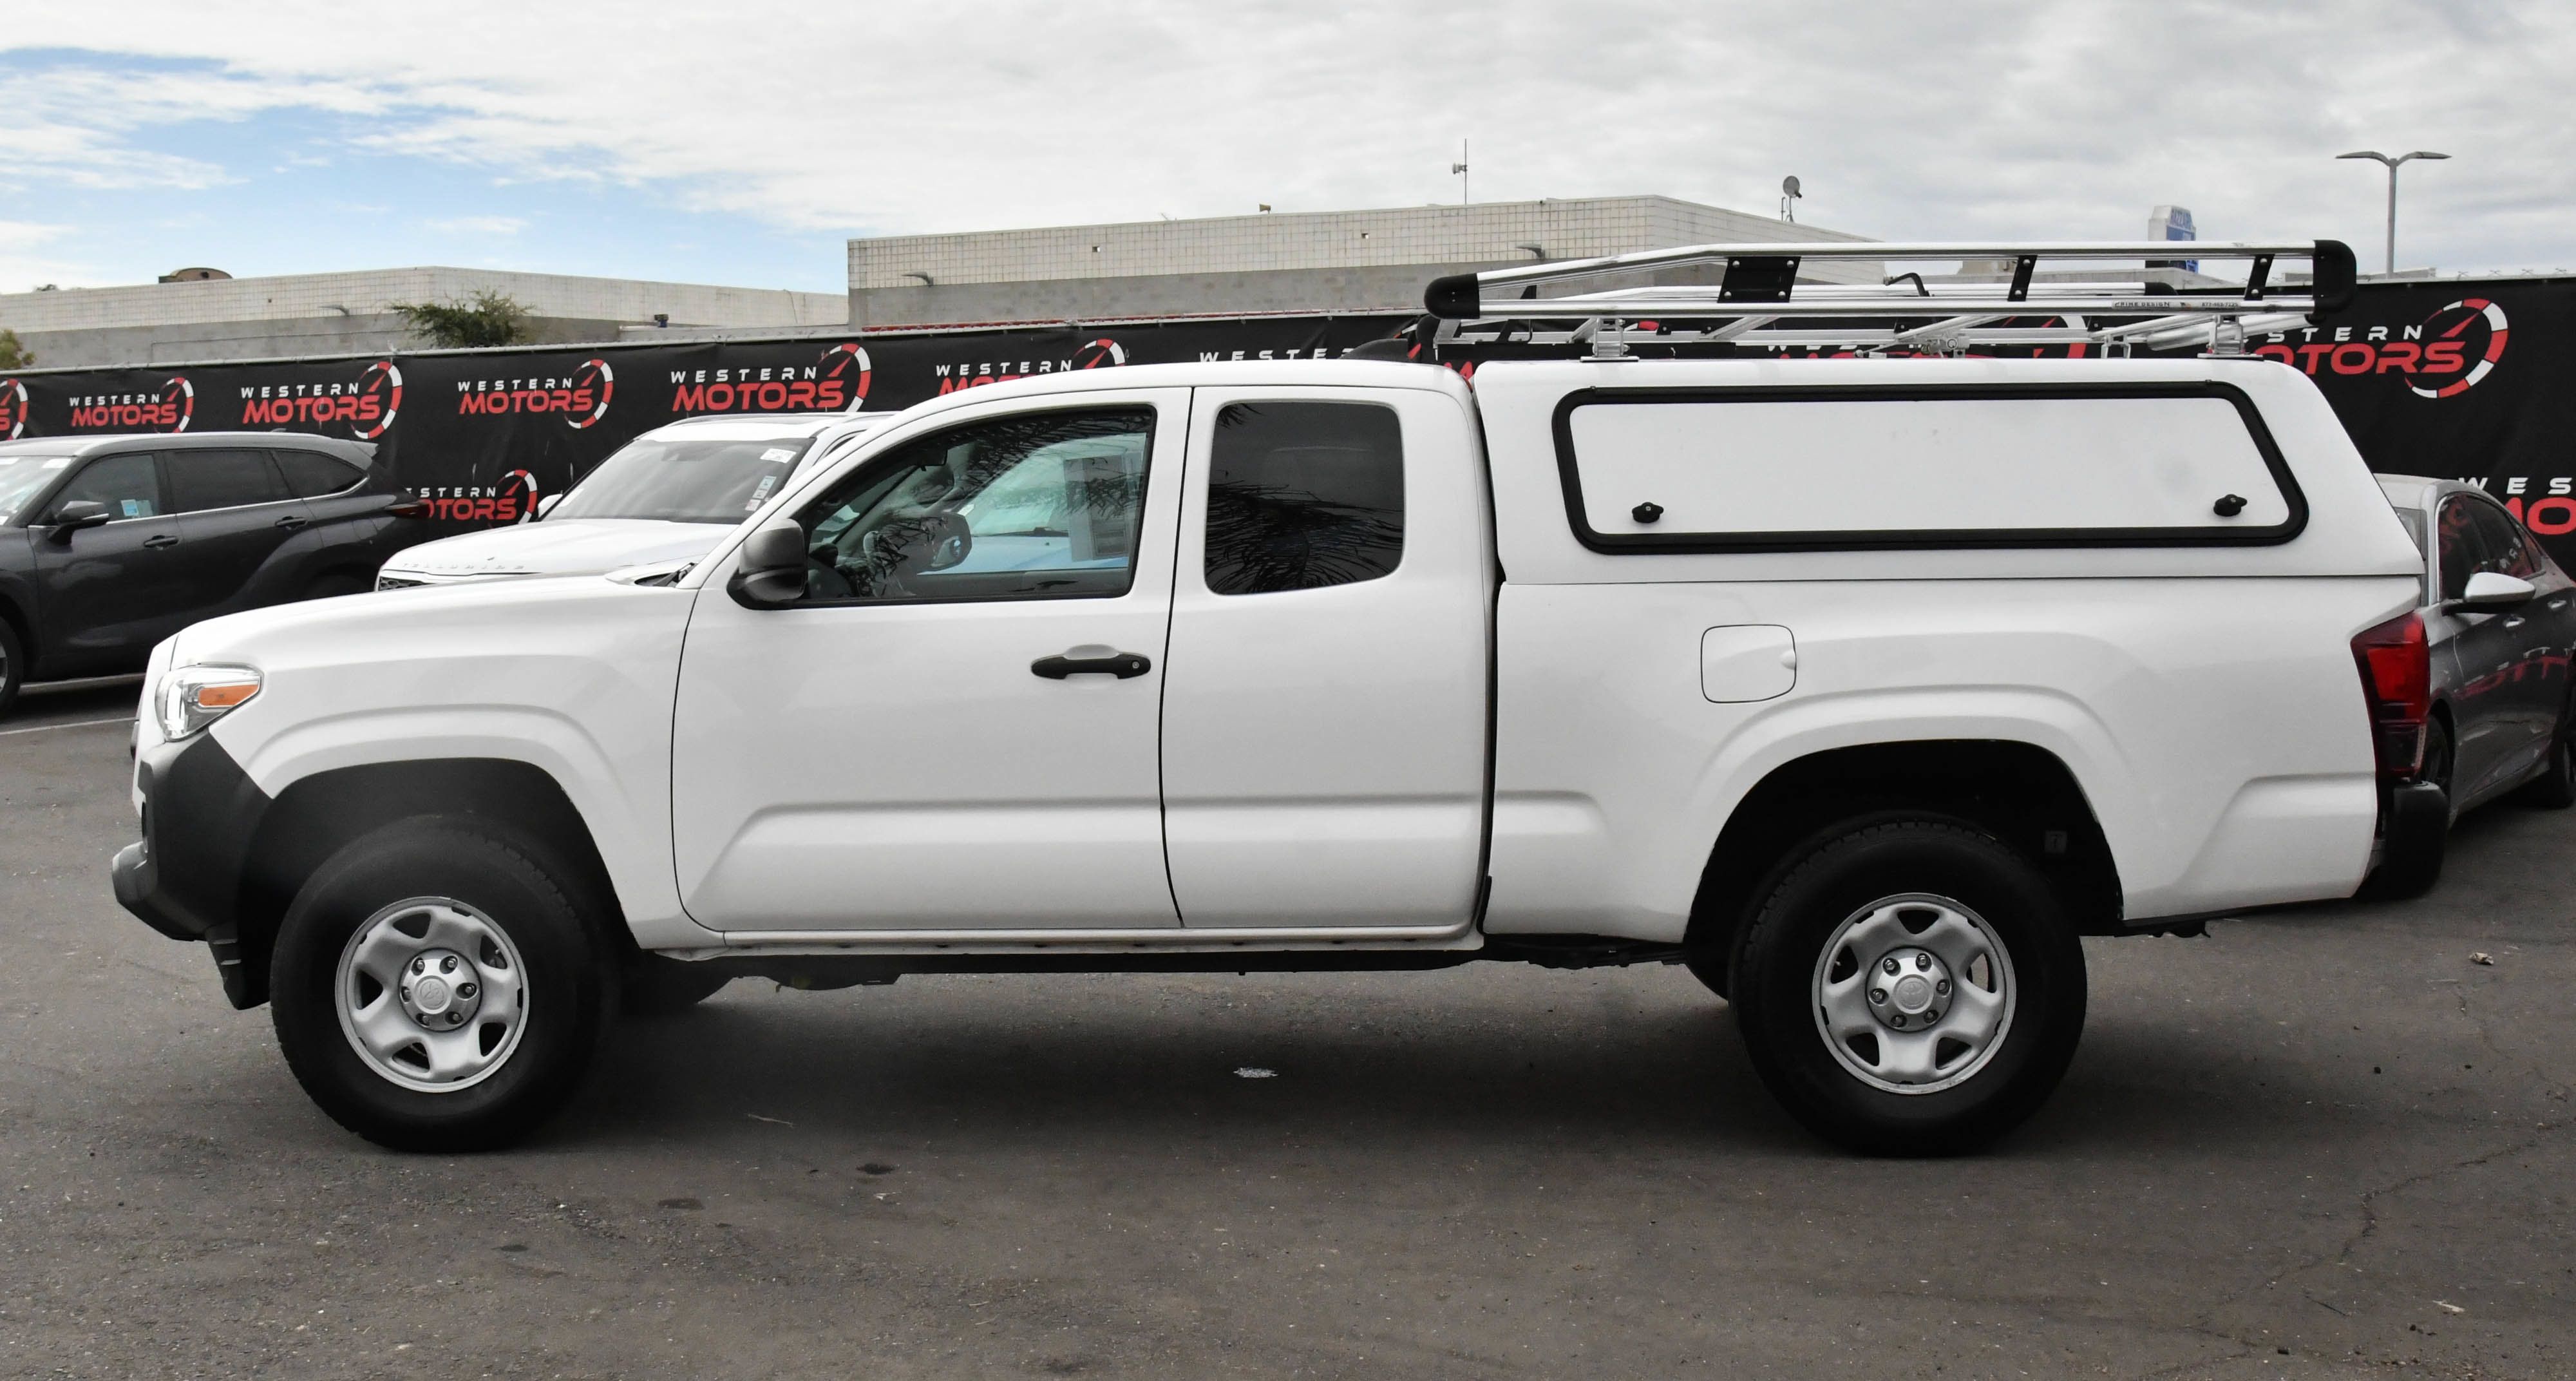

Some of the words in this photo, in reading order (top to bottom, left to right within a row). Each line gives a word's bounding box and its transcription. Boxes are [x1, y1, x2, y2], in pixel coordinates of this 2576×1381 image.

[2244, 325, 2422, 343] STERN
[1199, 348, 1356, 362] WESTE
[2255, 341, 2466, 375] OTORS
[670, 367, 817, 384] WESTERN
[936, 359, 1072, 376] WESTERN
[241, 383, 359, 399] WESTERN
[458, 377, 573, 392] WESTERN
[69, 394, 160, 407] WESTERN
[459, 388, 593, 415] MOTORS
[672, 380, 844, 412] MOTORS
[71, 403, 178, 427] MOTORS
[242, 395, 381, 424] MOTORS
[406, 487, 496, 498] STERN
